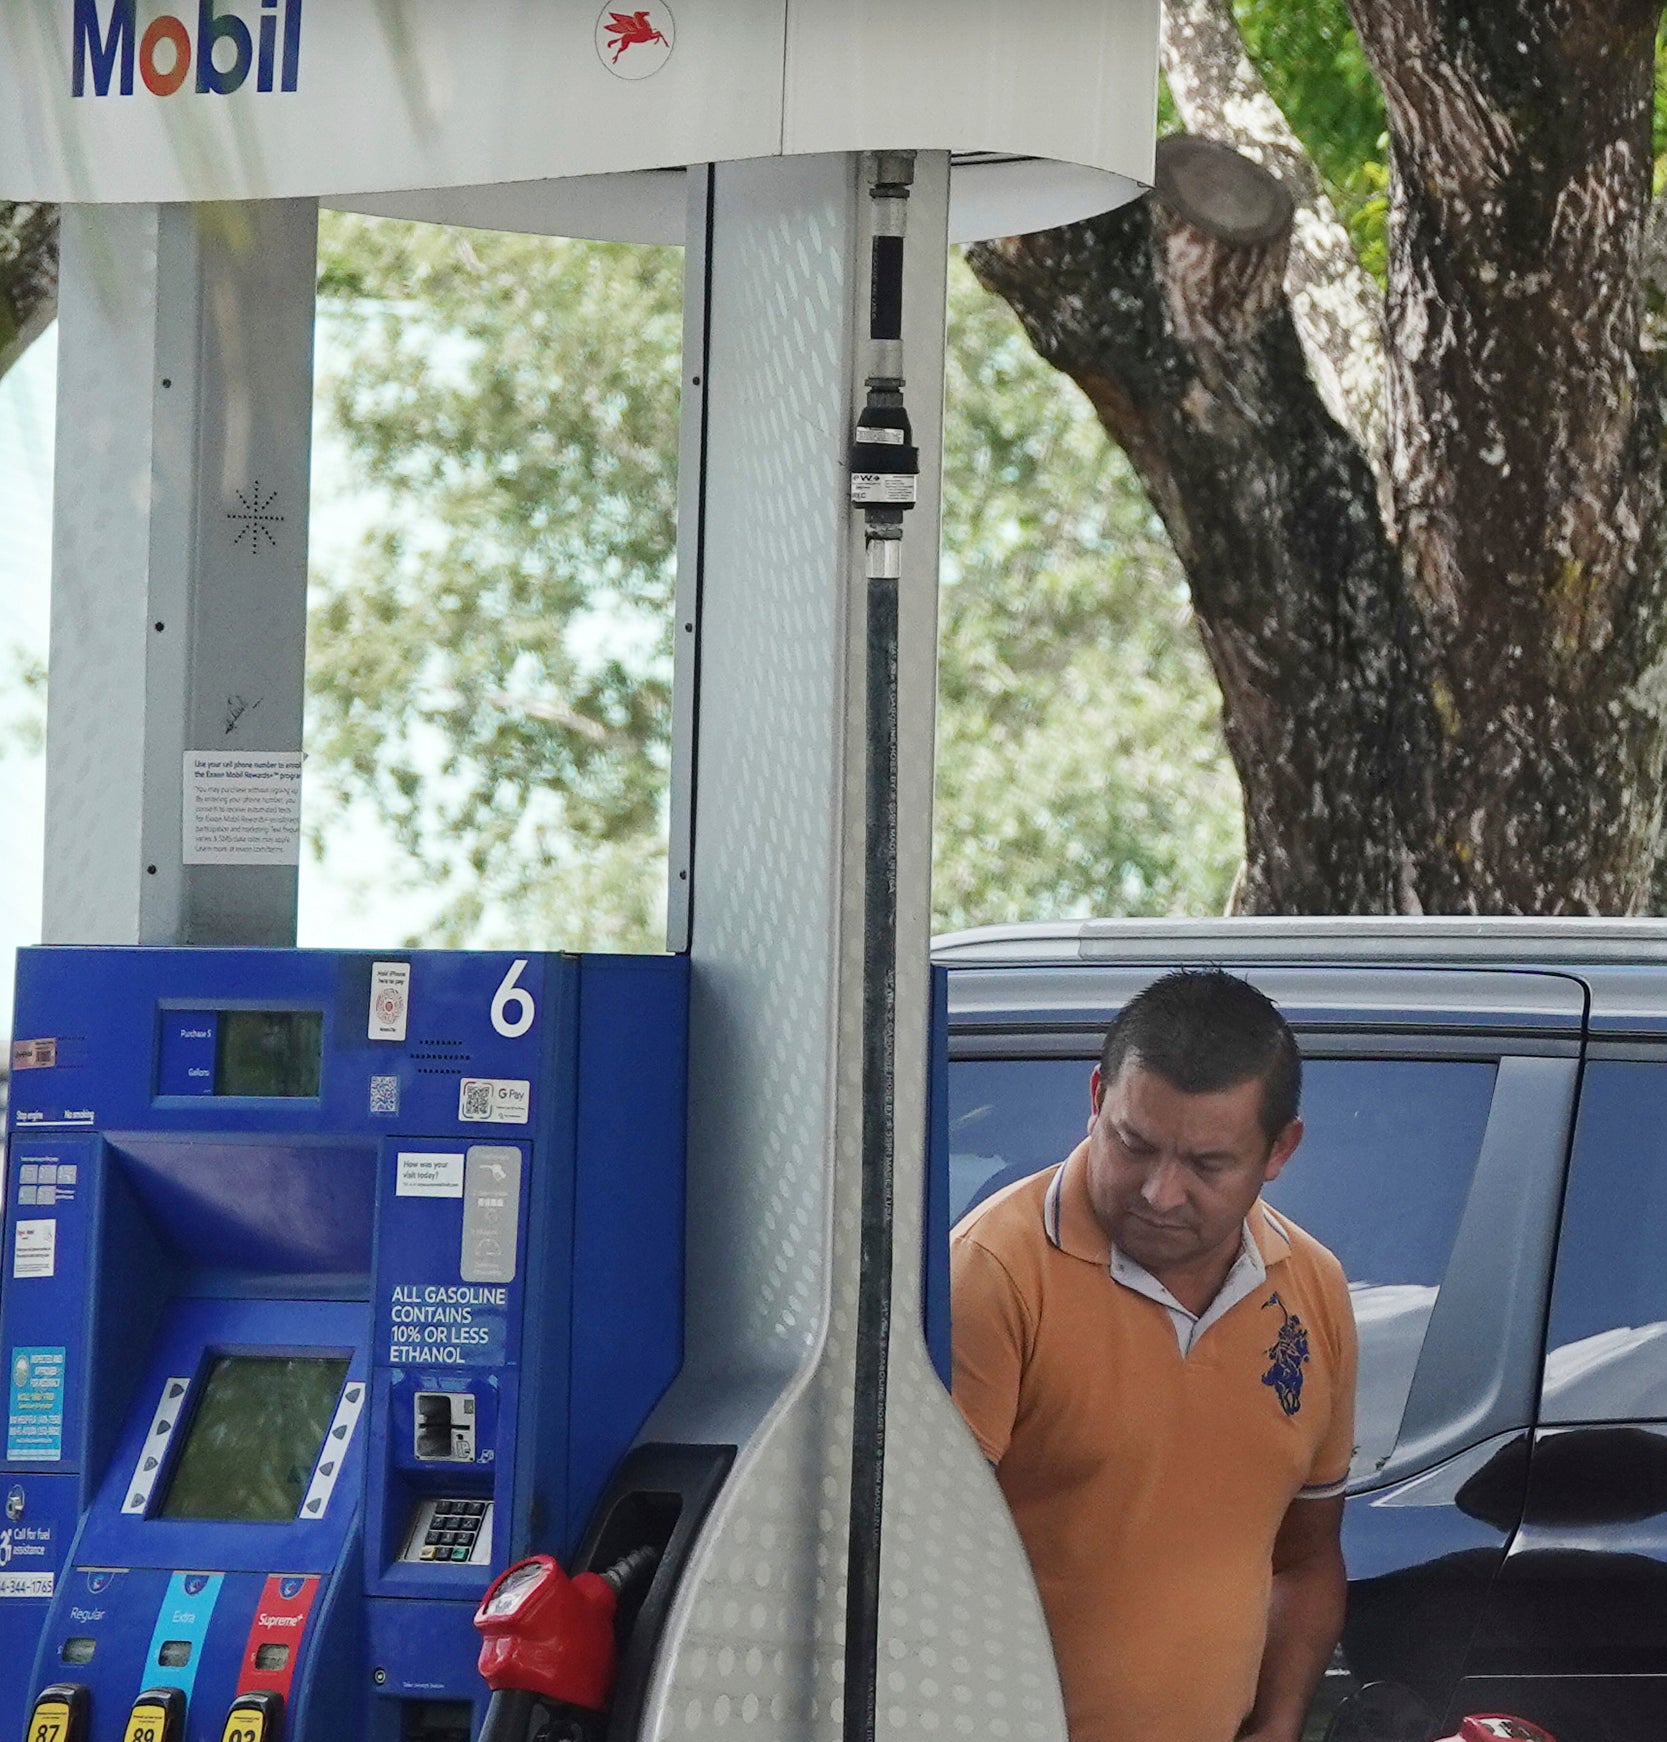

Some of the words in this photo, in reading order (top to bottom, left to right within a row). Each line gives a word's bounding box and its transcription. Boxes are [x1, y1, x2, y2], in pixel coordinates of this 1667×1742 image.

[72, 0, 300, 97] Mobil
[490, 959, 535, 1038] 6
[188, 1067, 210, 1077] Gallons
[498, 1087, 507, 1099] G
[508, 1088, 525, 1102] Pay
[403, 1160, 418, 1168] How
[419, 1161, 432, 1169] was
[433, 1161, 449, 1170] your
[402, 1171, 416, 1179] visit
[417, 1171, 439, 1180] today?
[391, 1286, 422, 1303] ALL
[424, 1286, 506, 1305] GASOLINE
[391, 1305, 472, 1324] CONTAINS
[391, 1325, 421, 1343] 10%
[424, 1326, 448, 1343] OR
[451, 1326, 489, 1344] LESS
[389, 1345, 466, 1364] ETHANOL
[13, 1528, 26, 1540] Call
[26, 1527, 37, 1540] for
[37, 1527, 51, 1540] fuel
[13, 1542, 45, 1555] assistance
[70, 1606, 105, 1624] Regular
[171, 1610, 196, 1624] Extra
